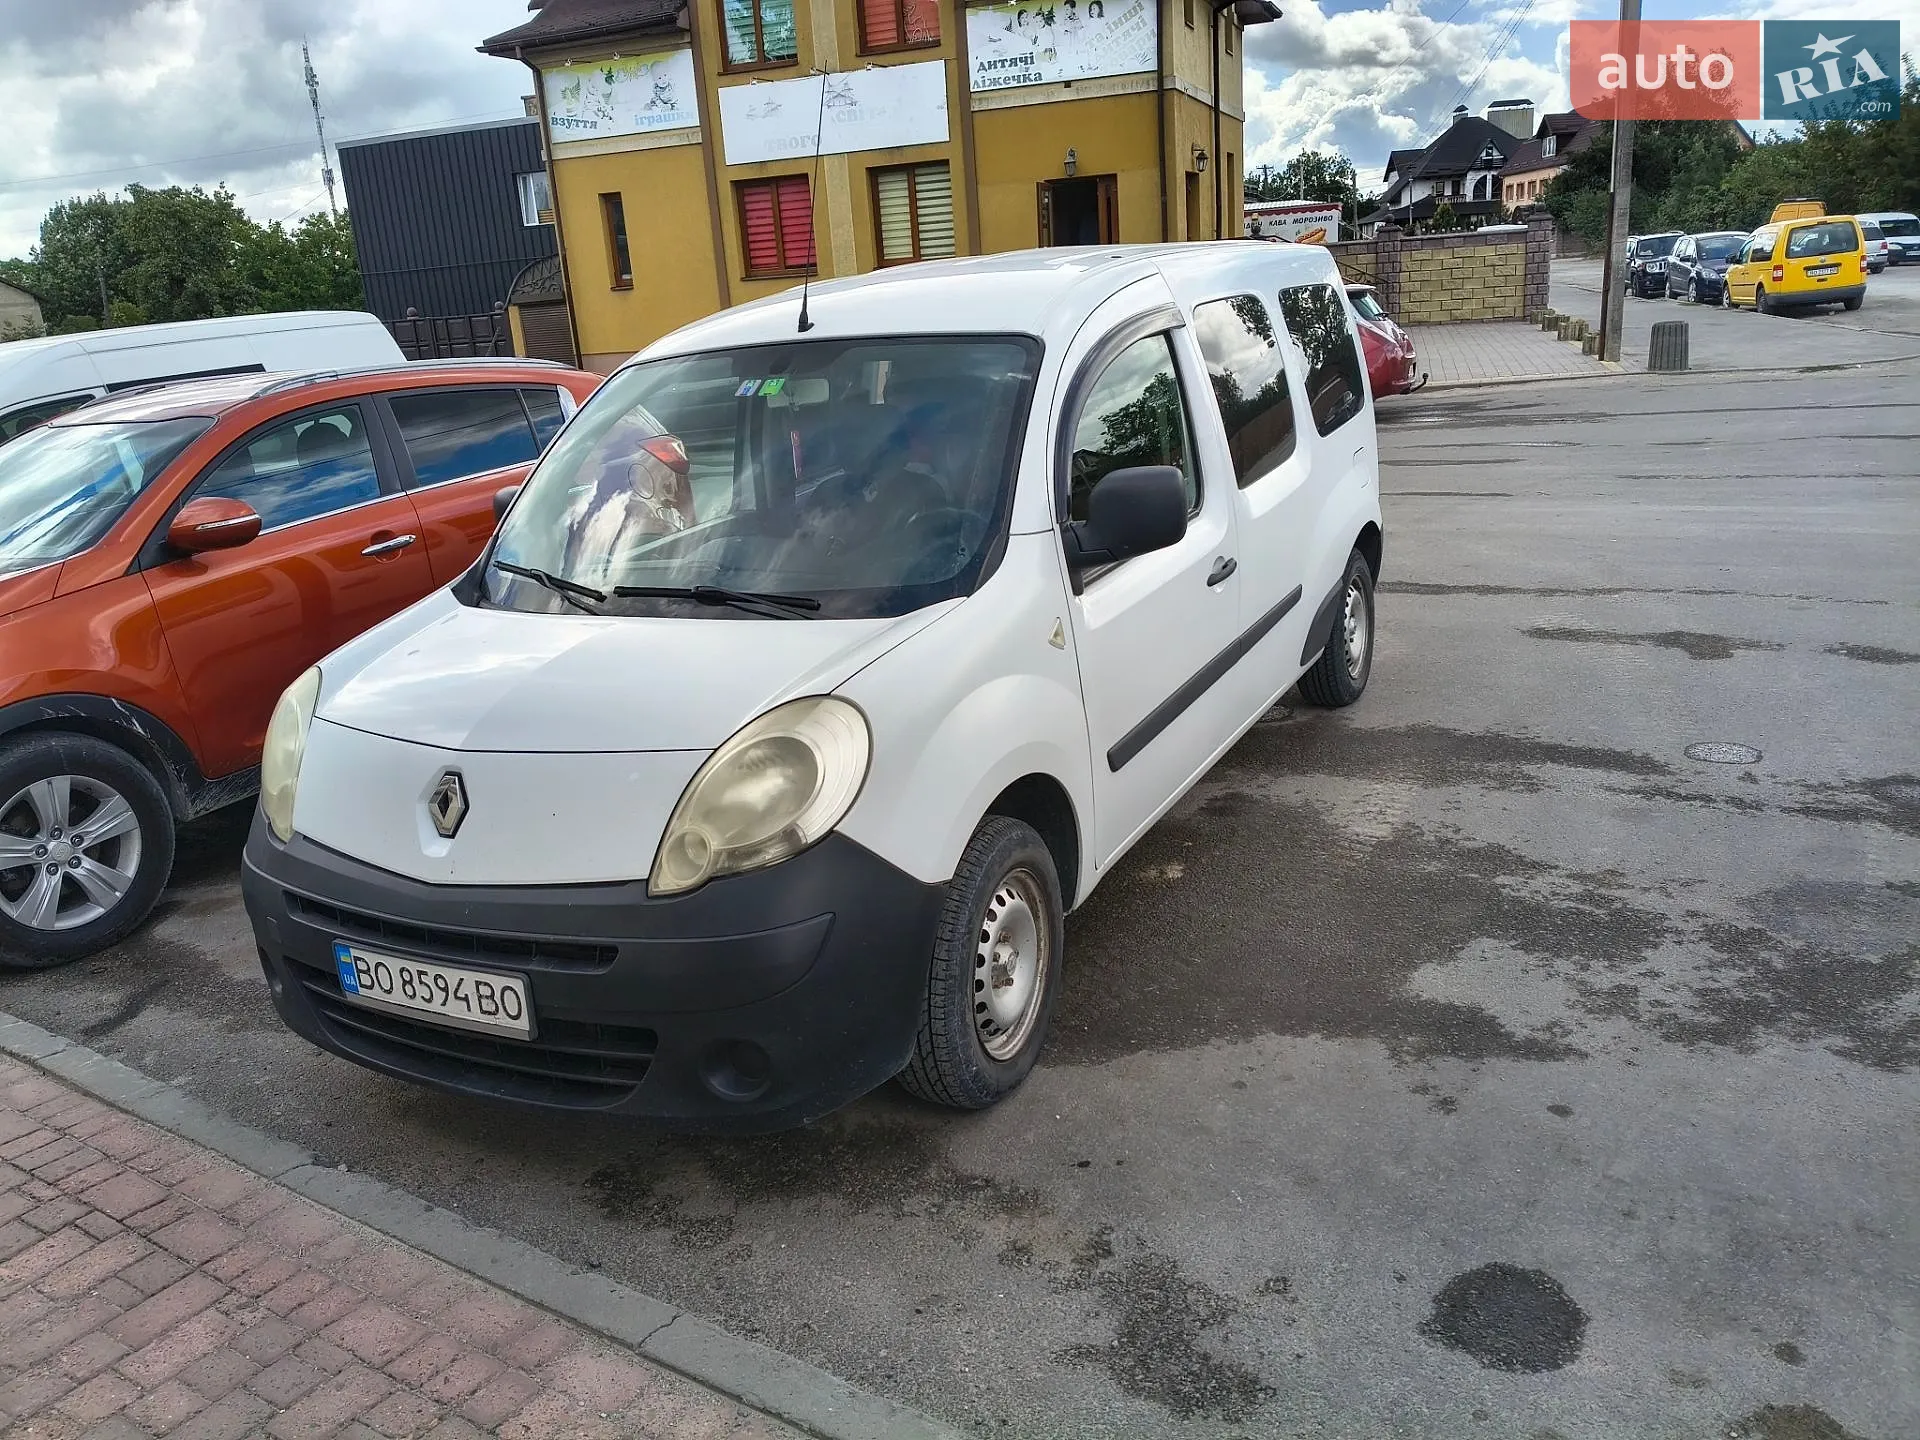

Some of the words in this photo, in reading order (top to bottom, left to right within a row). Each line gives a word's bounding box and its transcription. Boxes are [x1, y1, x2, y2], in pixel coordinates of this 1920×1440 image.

[1105, 0, 1145, 33] інші
[977, 52, 1035, 73] дитячі
[972, 70, 1043, 90] ліжечка
[551, 116, 598, 130] взуття
[634, 110, 694, 126] іграшки
[1268, 219, 1287, 227] КАВА
[1292, 214, 1333, 225] МОРОЗИВО
[344, 973, 356, 986] UA
